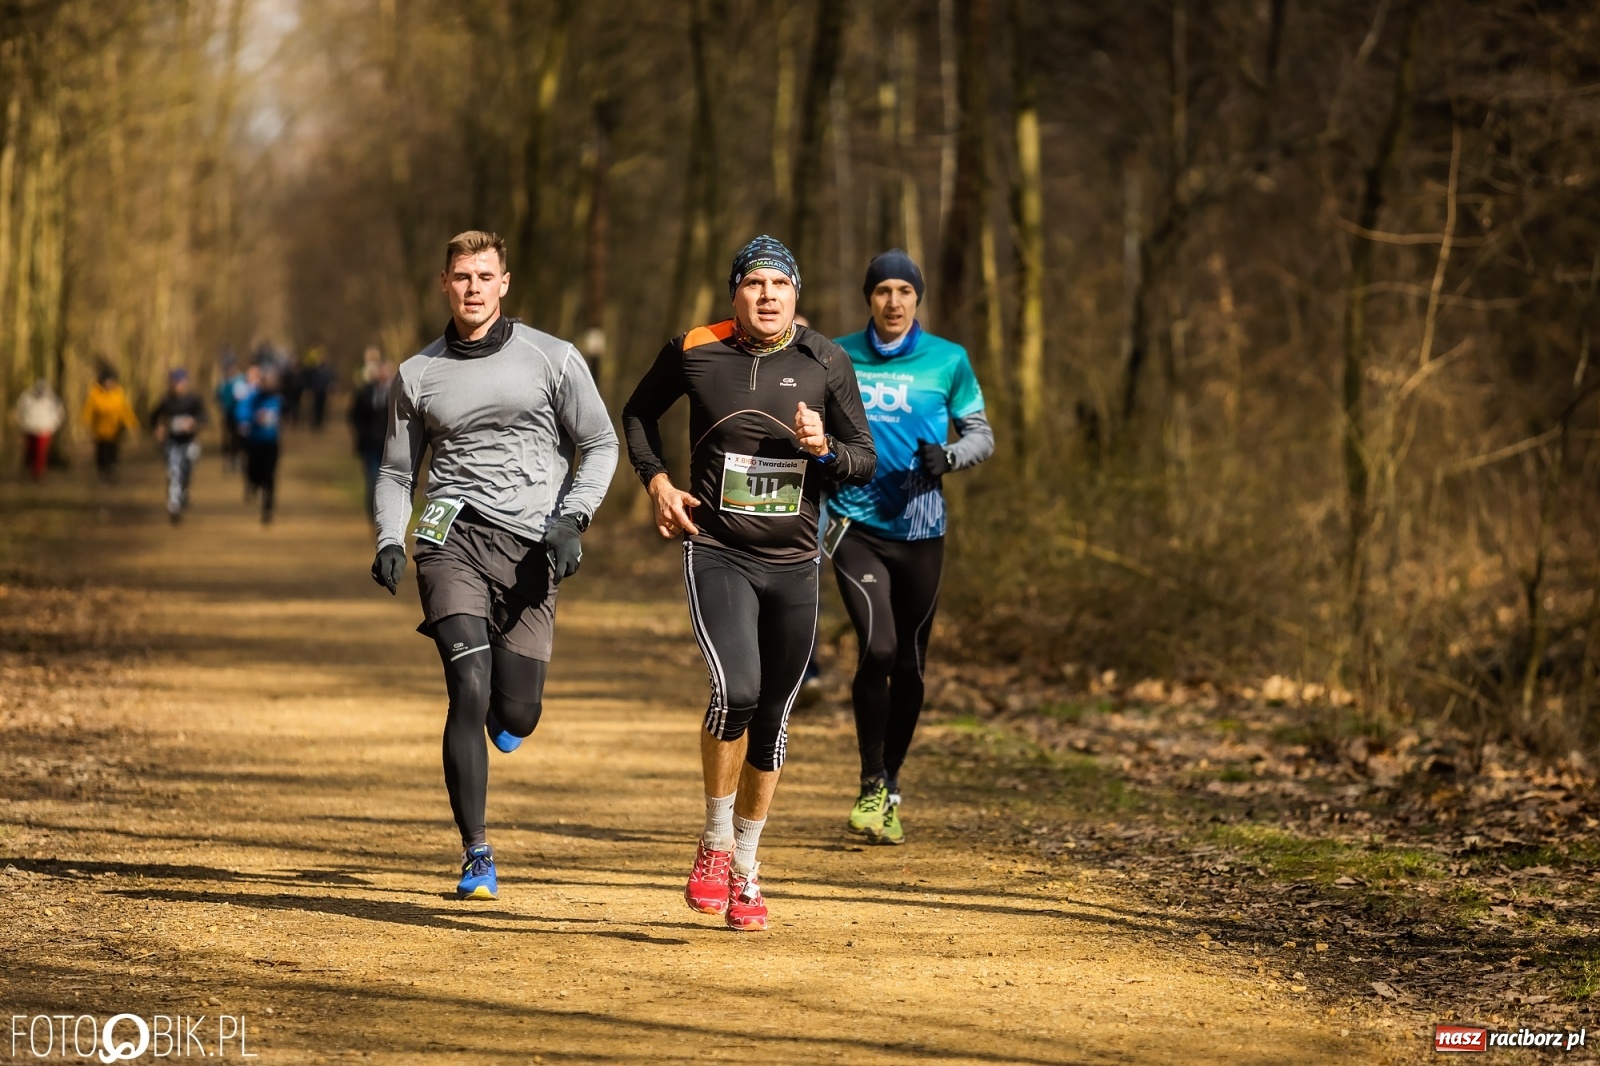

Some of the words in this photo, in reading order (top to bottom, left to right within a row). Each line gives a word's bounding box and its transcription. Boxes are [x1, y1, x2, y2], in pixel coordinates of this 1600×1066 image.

[741, 458, 757, 466] BIEG
[758, 460, 798, 469] Twardziela
[750, 476, 778, 499] 111
